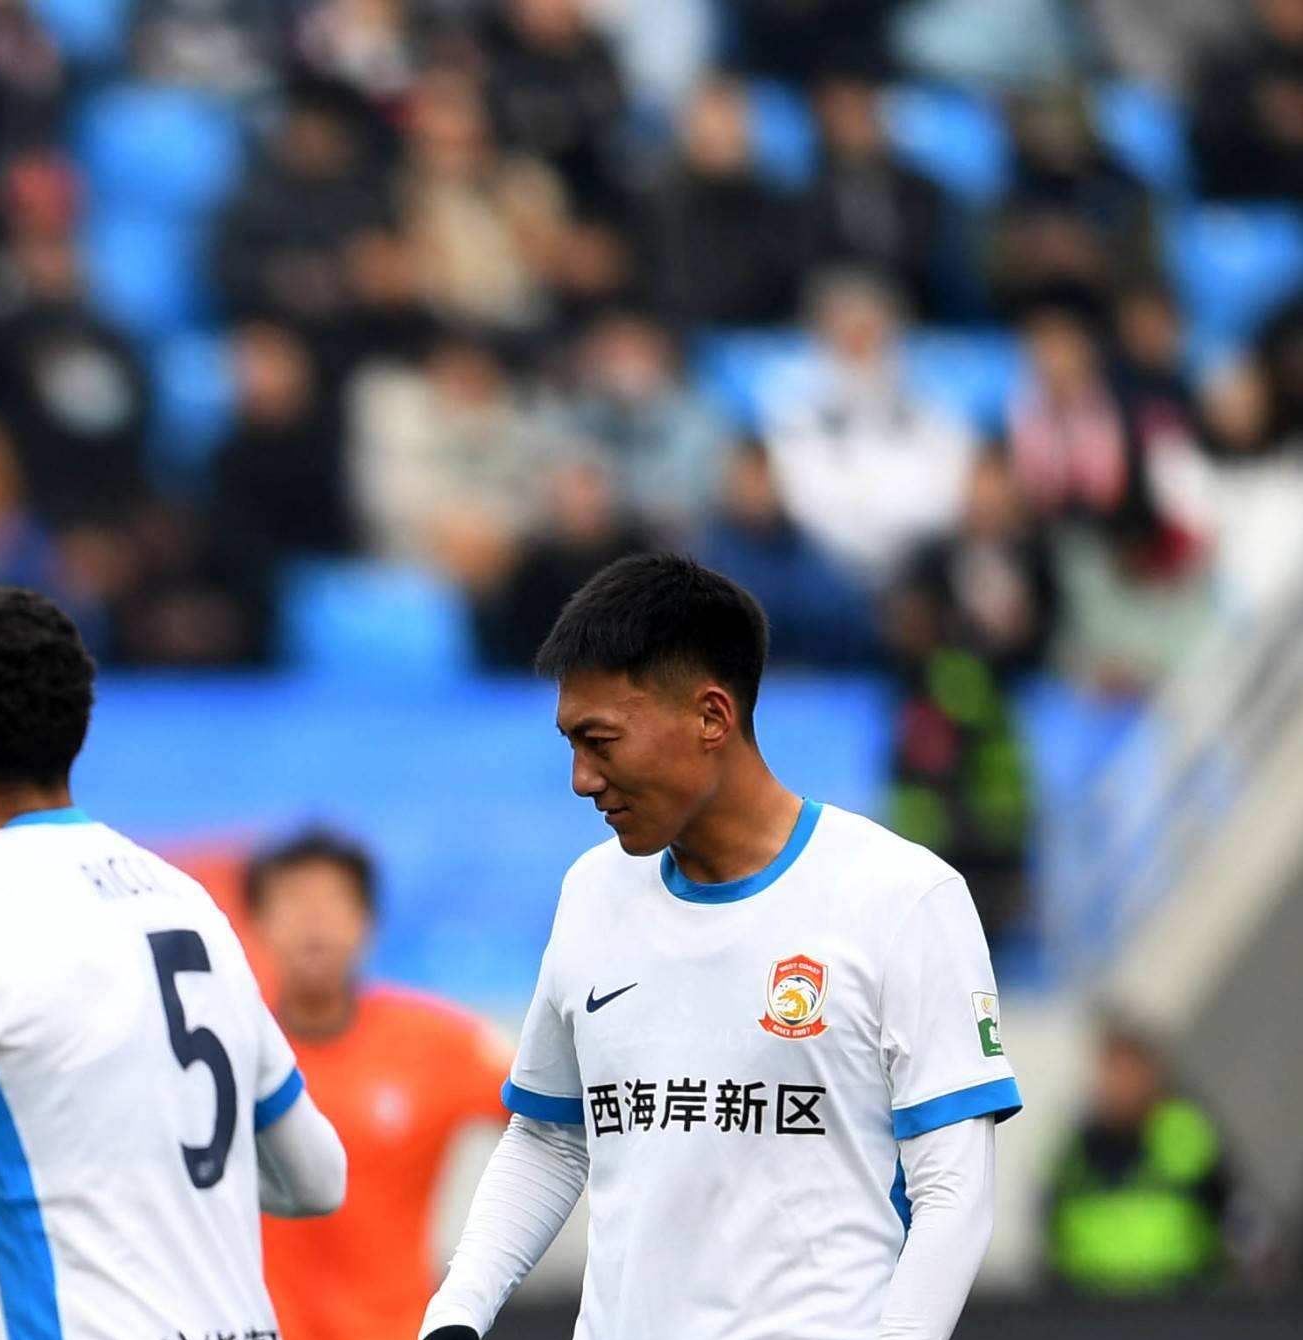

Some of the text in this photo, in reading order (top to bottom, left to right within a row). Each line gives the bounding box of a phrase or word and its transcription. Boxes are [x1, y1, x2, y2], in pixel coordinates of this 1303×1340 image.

[146, 929, 237, 1190] 5
[587, 1078, 827, 1138] 西海岸新区
